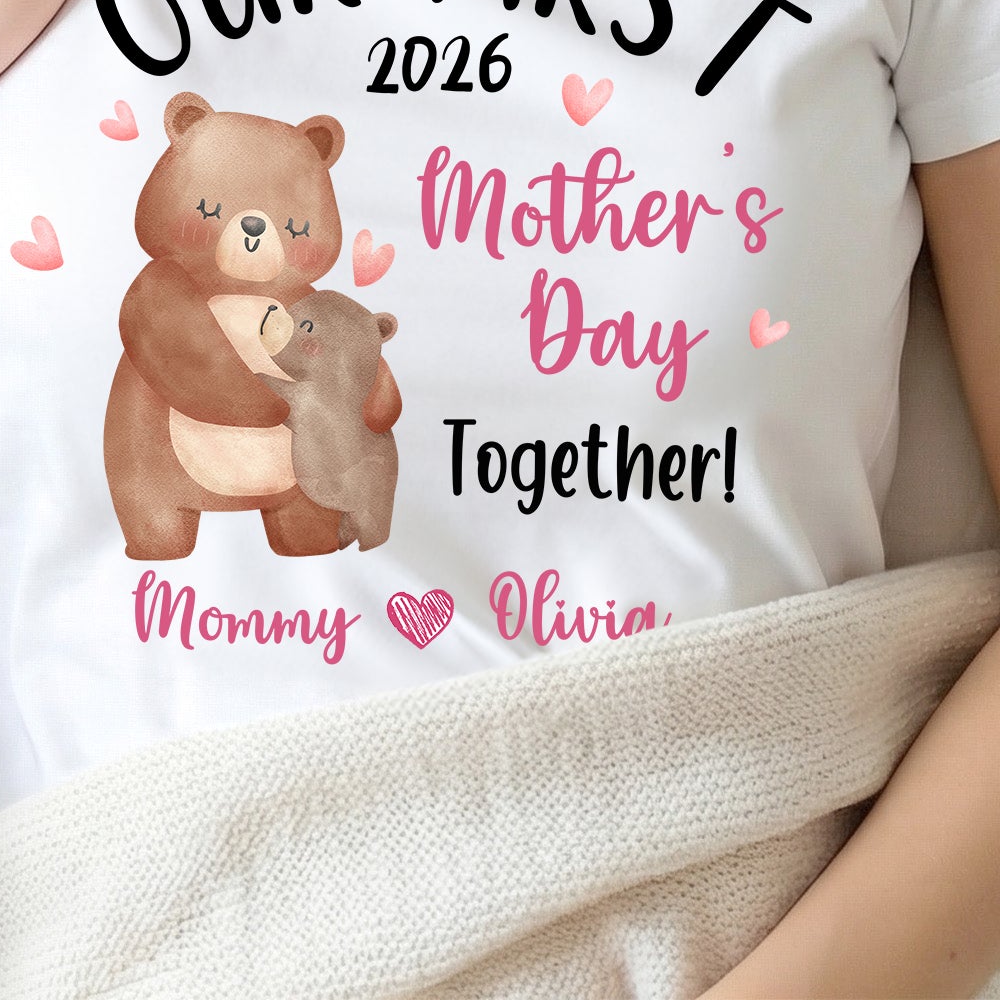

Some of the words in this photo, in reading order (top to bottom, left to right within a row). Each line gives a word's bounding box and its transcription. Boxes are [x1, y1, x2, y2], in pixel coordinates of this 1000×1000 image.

[366, 32, 512, 94] 2026
[417, 141, 784, 261] Mother's
[521, 268, 710, 403] Day
[443, 418, 738, 515] Together!
[131, 569, 362, 665] Mommy
